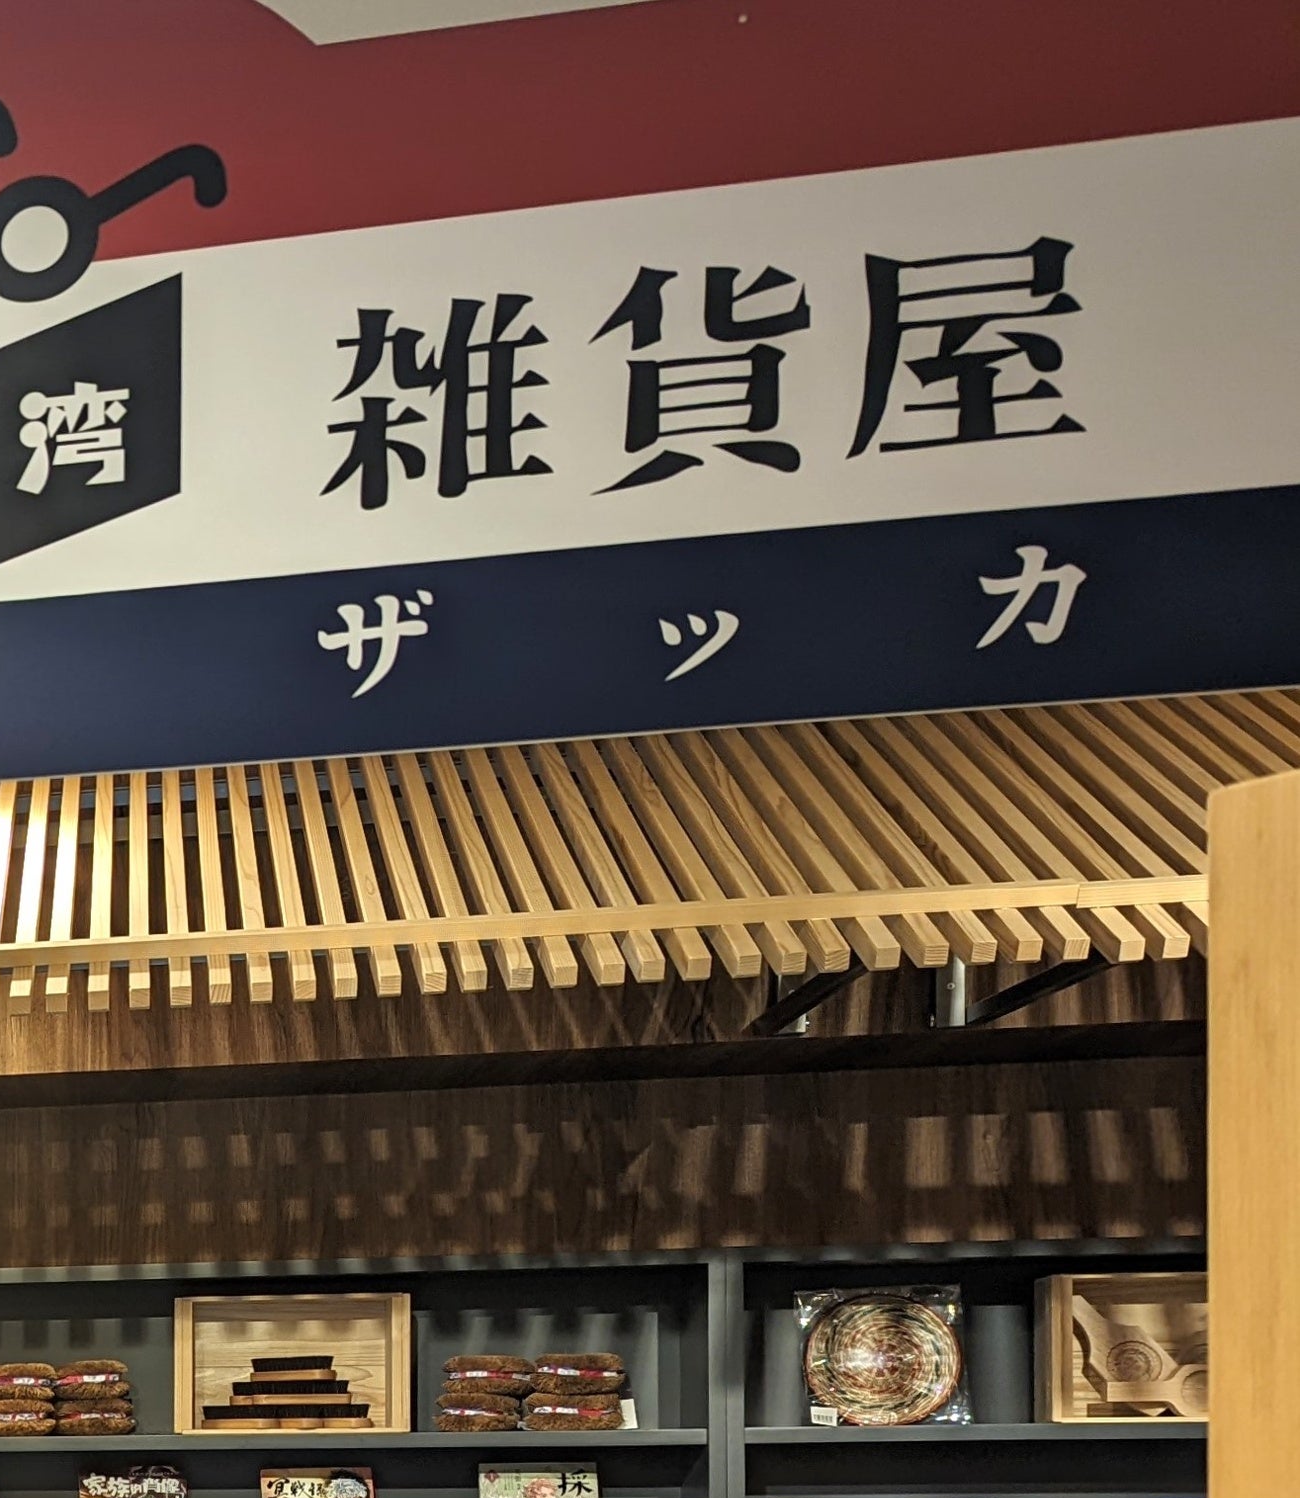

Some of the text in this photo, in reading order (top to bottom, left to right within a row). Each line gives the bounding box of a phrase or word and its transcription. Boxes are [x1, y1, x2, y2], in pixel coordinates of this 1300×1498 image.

[320, 236, 1087, 510] 雑貨屋
[318, 545, 1087, 698] ザッカ
